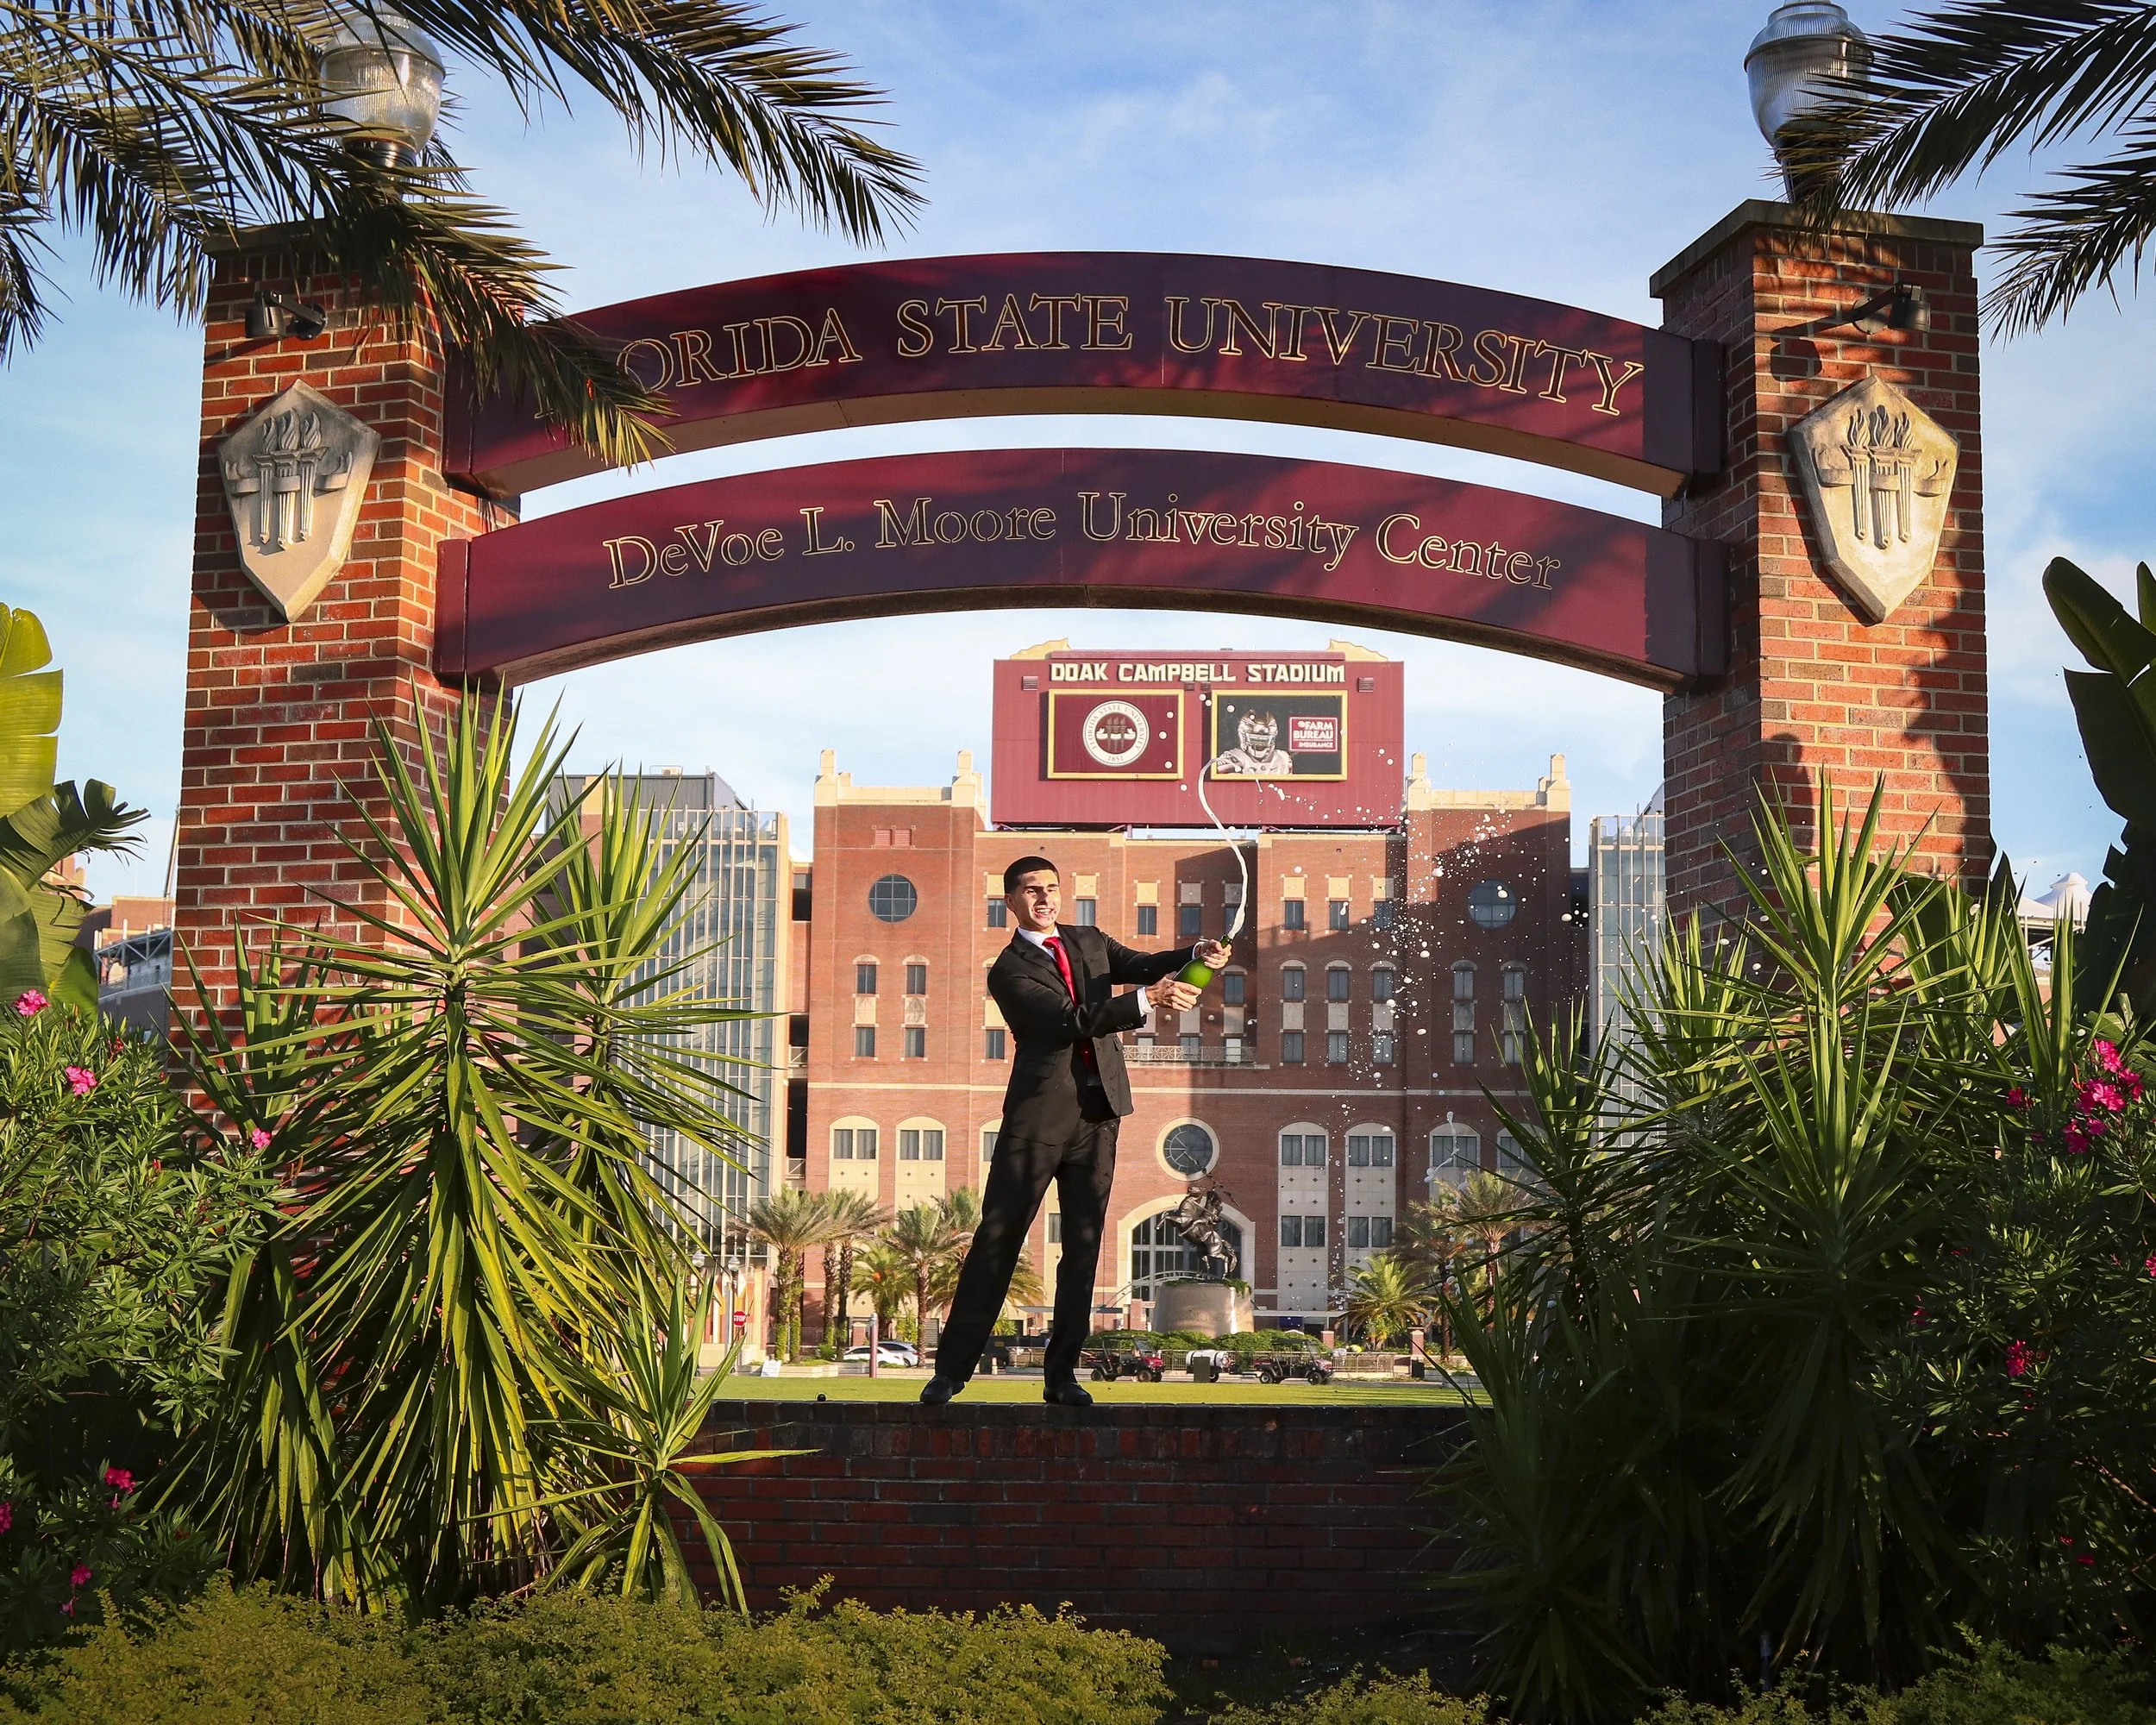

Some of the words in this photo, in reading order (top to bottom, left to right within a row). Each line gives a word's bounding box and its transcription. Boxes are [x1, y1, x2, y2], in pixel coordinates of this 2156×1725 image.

[896, 292, 1132, 357] STATE
[1164, 296, 1645, 417] UNIVERSITY
[602, 519, 784, 589] DeVoe
[799, 506, 856, 556] L.
[873, 497, 1057, 549] Moore
[1077, 491, 1359, 572] University
[1376, 512, 1562, 591] Center
[1049, 662, 1109, 682] DOAK
[1118, 663, 1237, 682] CAMPBELL
[1247, 663, 1346, 683] STADIUM
[1099, 705, 1122, 716] STATE
[1125, 706, 1145, 750] UNIVERSITY
[1294, 730, 1333, 739] BUREAU
[1305, 721, 1333, 730] FARM
